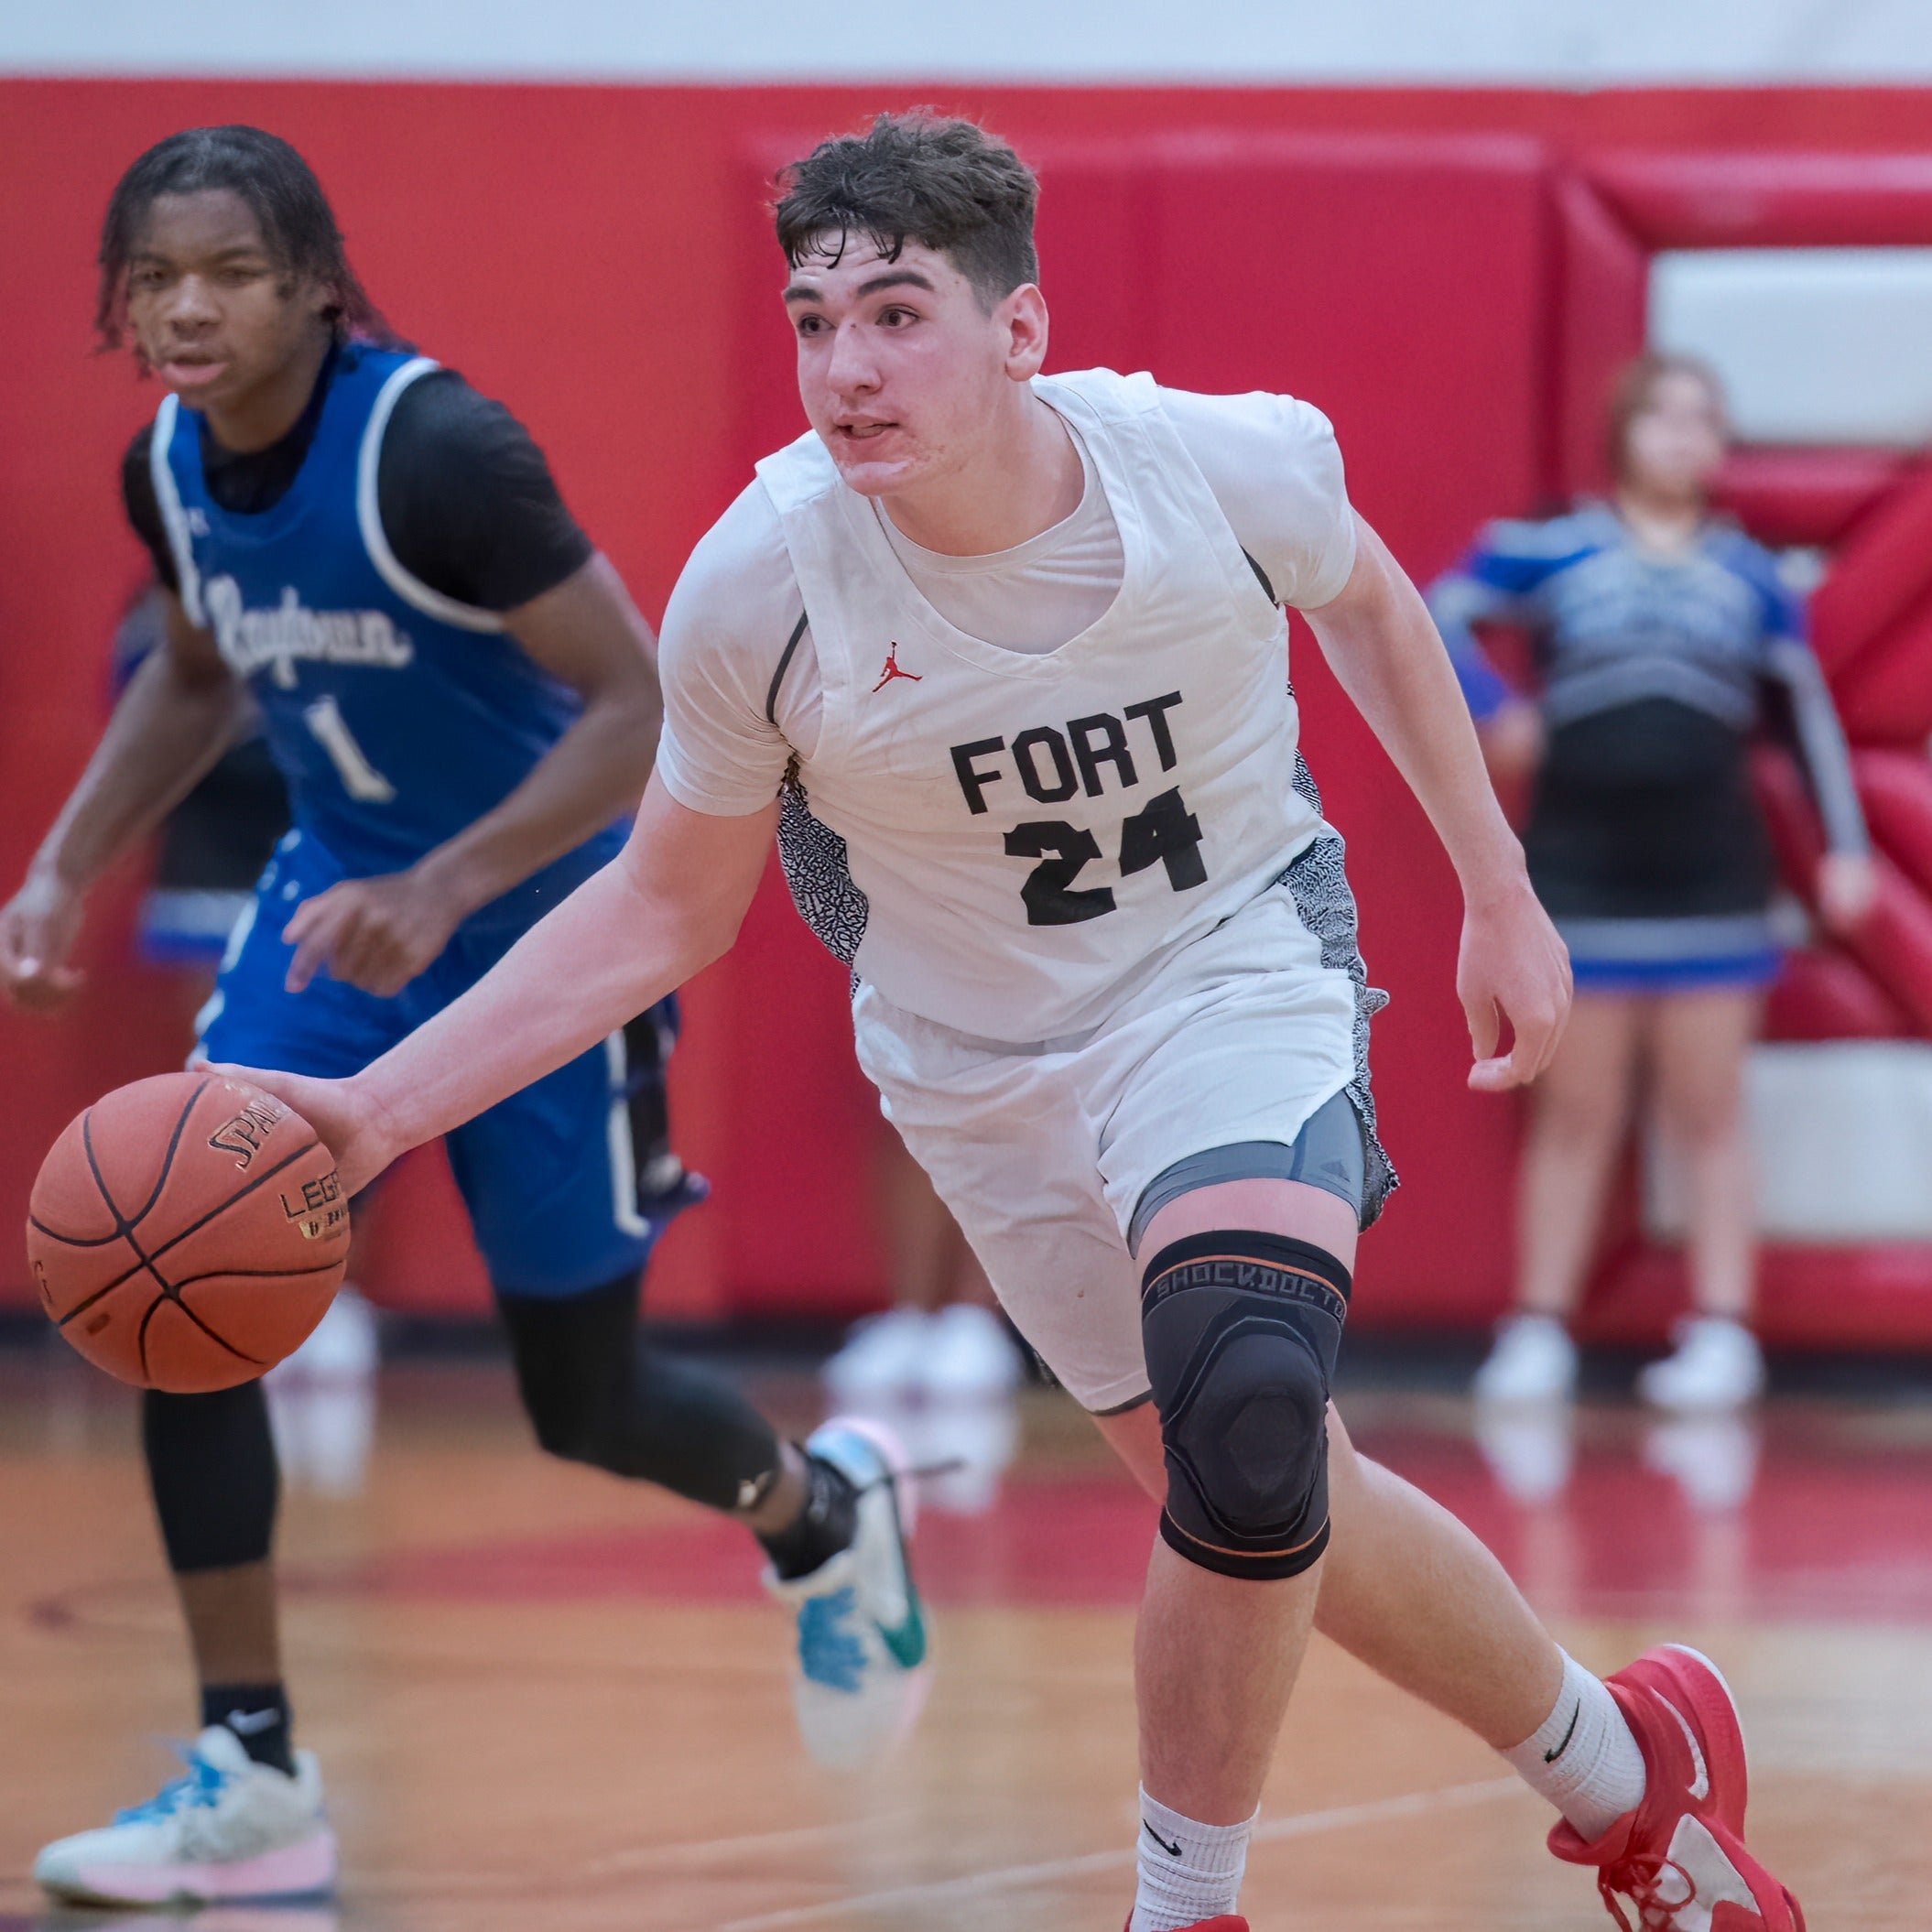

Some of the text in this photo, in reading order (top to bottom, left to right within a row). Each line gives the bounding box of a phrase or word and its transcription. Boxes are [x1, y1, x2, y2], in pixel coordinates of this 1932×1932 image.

[305, 694, 397, 803] 1
[950, 690, 1183, 815] FORT
[1003, 786, 1208, 926] 24
